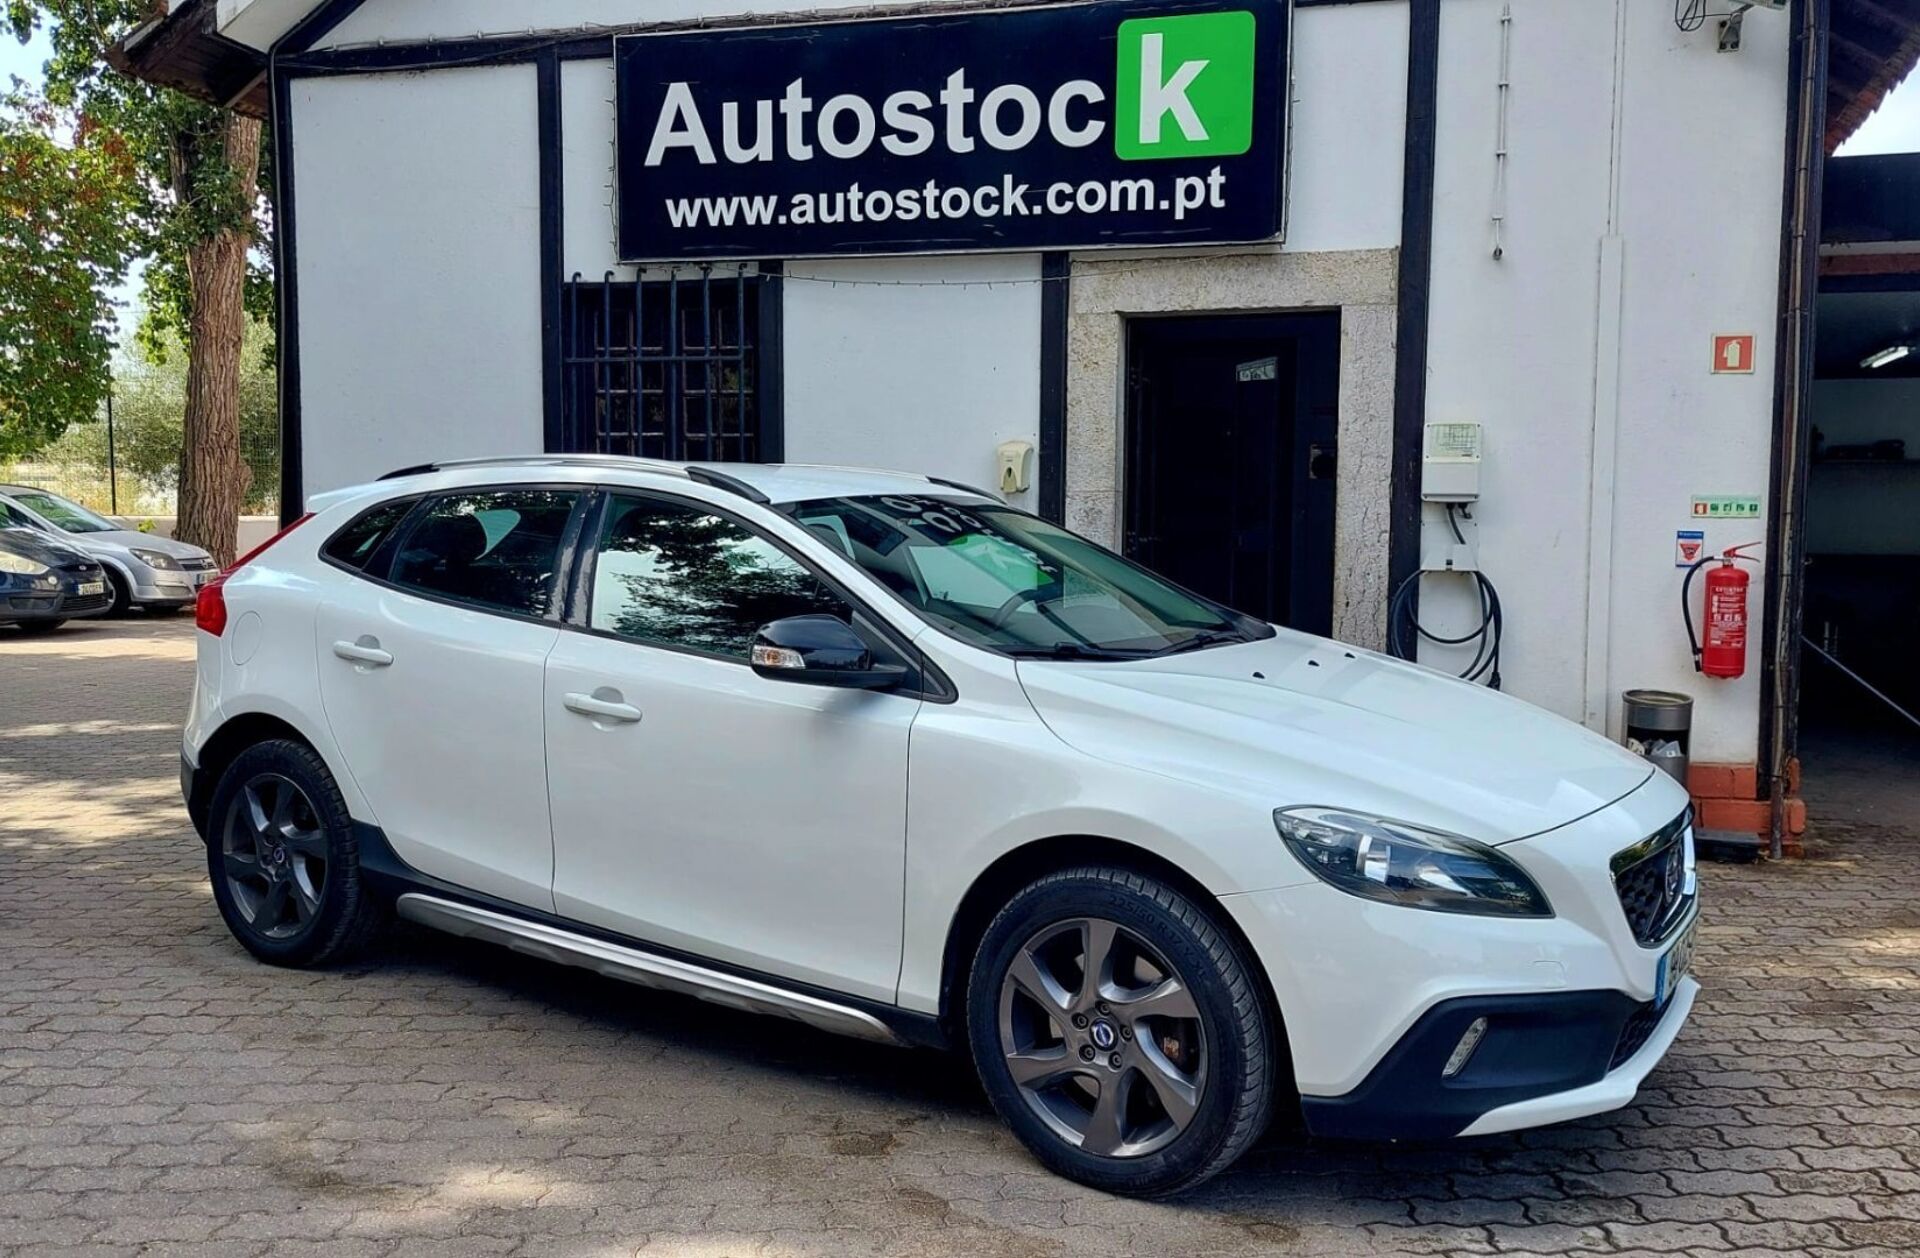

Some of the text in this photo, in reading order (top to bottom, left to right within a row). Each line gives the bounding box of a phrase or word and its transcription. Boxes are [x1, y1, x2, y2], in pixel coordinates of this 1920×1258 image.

[645, 34, 1208, 165] Autostock
[665, 166, 1227, 228] www.autostock.com.pt
[1108, 894, 1155, 924] 225/50
